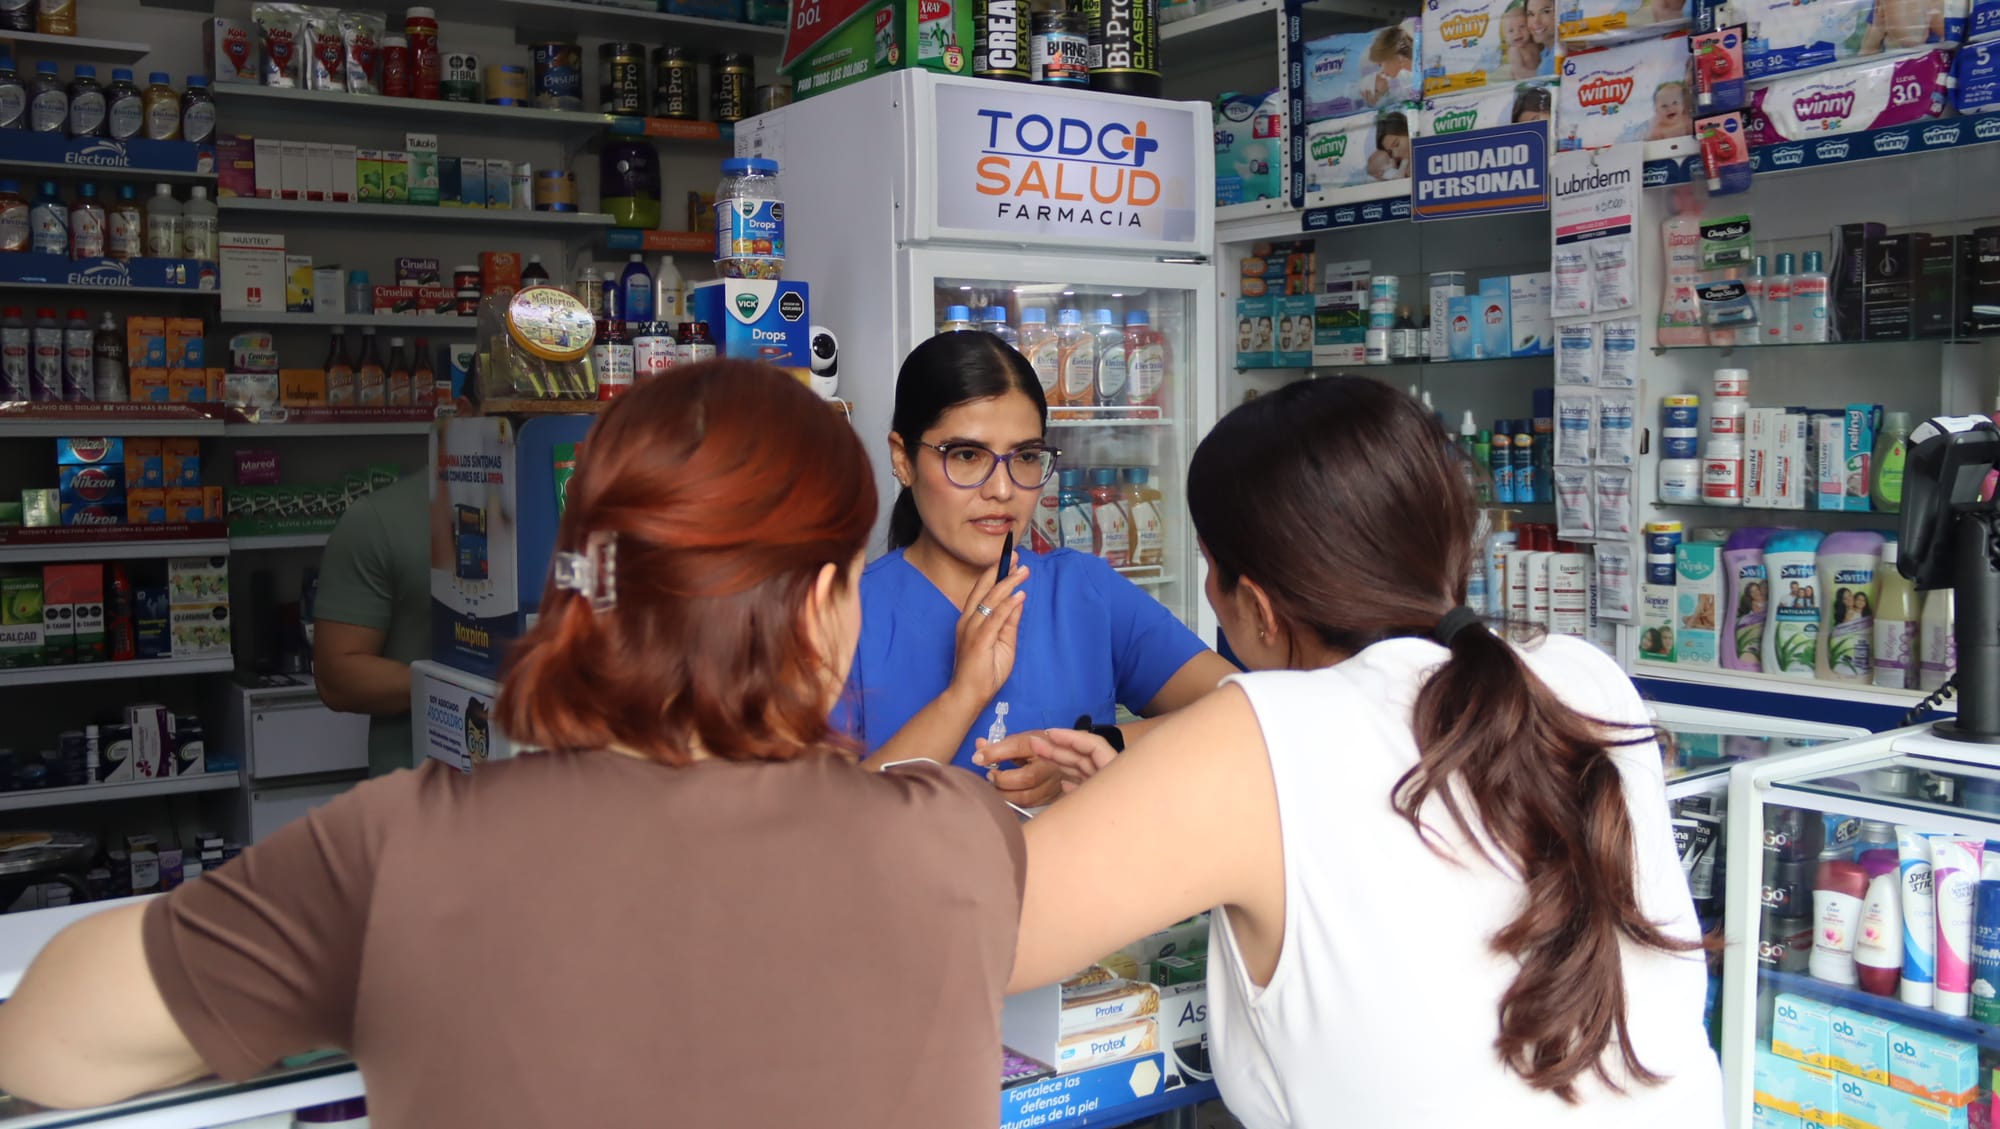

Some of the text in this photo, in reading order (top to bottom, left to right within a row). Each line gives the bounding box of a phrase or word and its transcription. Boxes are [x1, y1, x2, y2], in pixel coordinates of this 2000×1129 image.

[797, 5, 821, 30] DOL
[1976, 13, 1985, 24] 5
[1443, 17, 1487, 37] winny
[1768, 54, 1783, 66] 30
[1976, 47, 1991, 66] 5
[1315, 57, 1344, 73] winny
[450, 71, 477, 81] FIBRA
[797, 59, 868, 93] PARA TODOS LOS DOLORES
[1580, 79, 1630, 102] winny
[1892, 82, 1921, 104] 30
[1797, 93, 1852, 117] winny
[1436, 114, 1474, 133] winny
[1215, 132, 1234, 148] Slip
[1876, 138, 1908, 150] winny
[1924, 130, 1959, 143] winny
[1313, 137, 1345, 156] winny
[65, 151, 130, 167] Electrolit
[1428, 144, 1529, 175] CUIDADO
[975, 156, 1161, 206] SALUD
[1419, 168, 1539, 200] PERSONAL
[1555, 168, 1631, 197] Lubriderm
[998, 202, 1142, 227] FARMACIA
[749, 219, 776, 229] Drops
[400, 259, 437, 270] Ciruelax
[68, 272, 132, 287] Electrolit
[375, 287, 414, 298] Ciruelax
[419, 287, 456, 299] Ciruelax
[738, 300, 758, 308] VICK
[752, 329, 786, 341] Drops
[241, 457, 276, 472] Mareol
[460, 452, 502, 468] LOS SÍNTOMAS
[70, 477, 116, 488] Nikzon
[448, 471, 473, 483] COMUNES
[474, 472, 480, 483] DE
[480, 472, 487, 483] LA
[72, 513, 117, 524] Nikzon
[1909, 872, 1932, 883] SPEE
[1096, 1003, 1124, 1017] Protex
[1178, 1000, 1207, 1027] As
[1091, 1036, 1126, 1055] Protex
[1001, 1068, 1039, 1083] ALLS
[1010, 1075, 1080, 1103] Fortalece las
[1020, 1092, 1070, 1115] defensas
[1000, 1097, 1099, 1129] aturales de la piel
